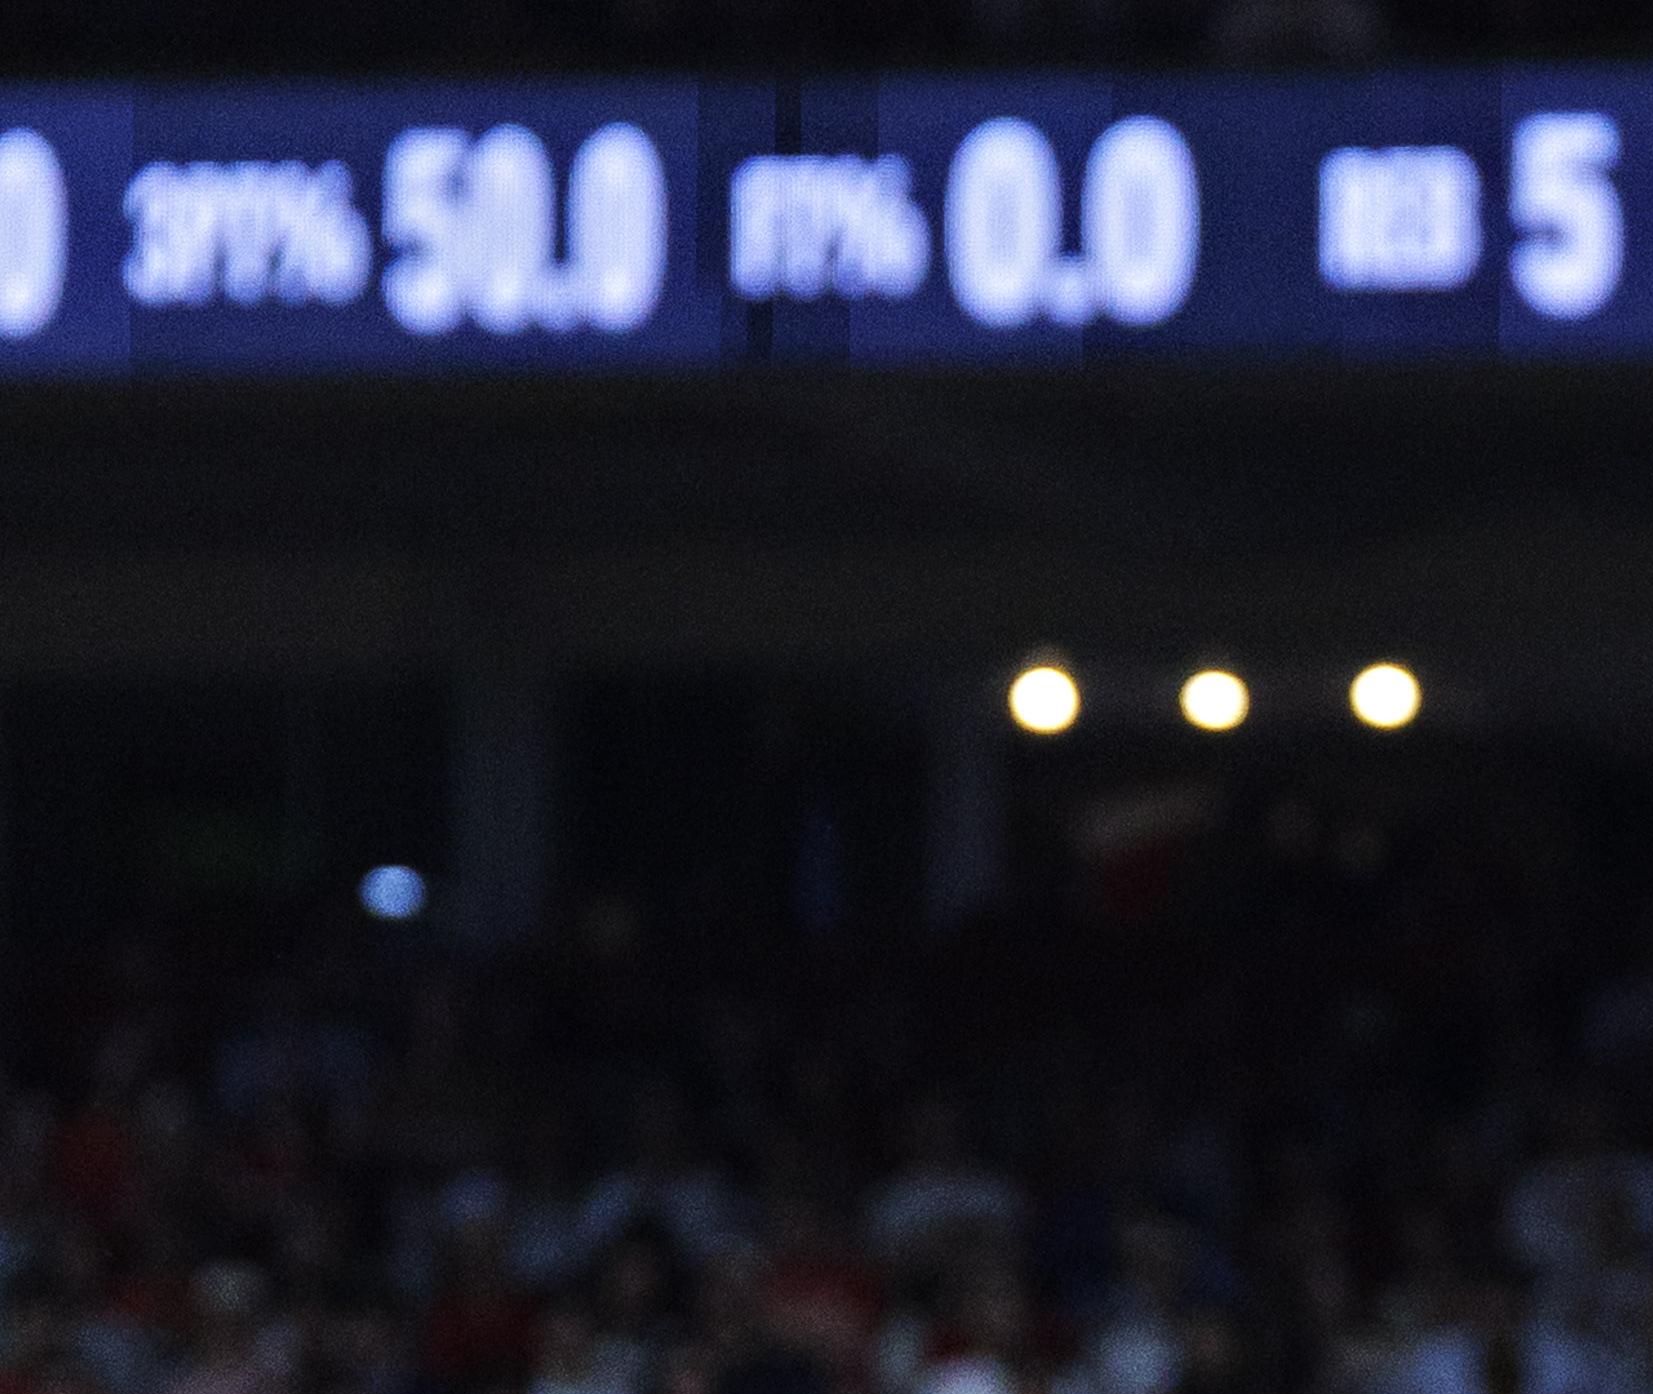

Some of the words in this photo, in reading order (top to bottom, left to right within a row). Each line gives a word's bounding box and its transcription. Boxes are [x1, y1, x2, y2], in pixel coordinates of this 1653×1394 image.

[383, 124, 667, 333] 50.0
[945, 116, 1199, 327] 0.0
[1511, 112, 1623, 318] 5
